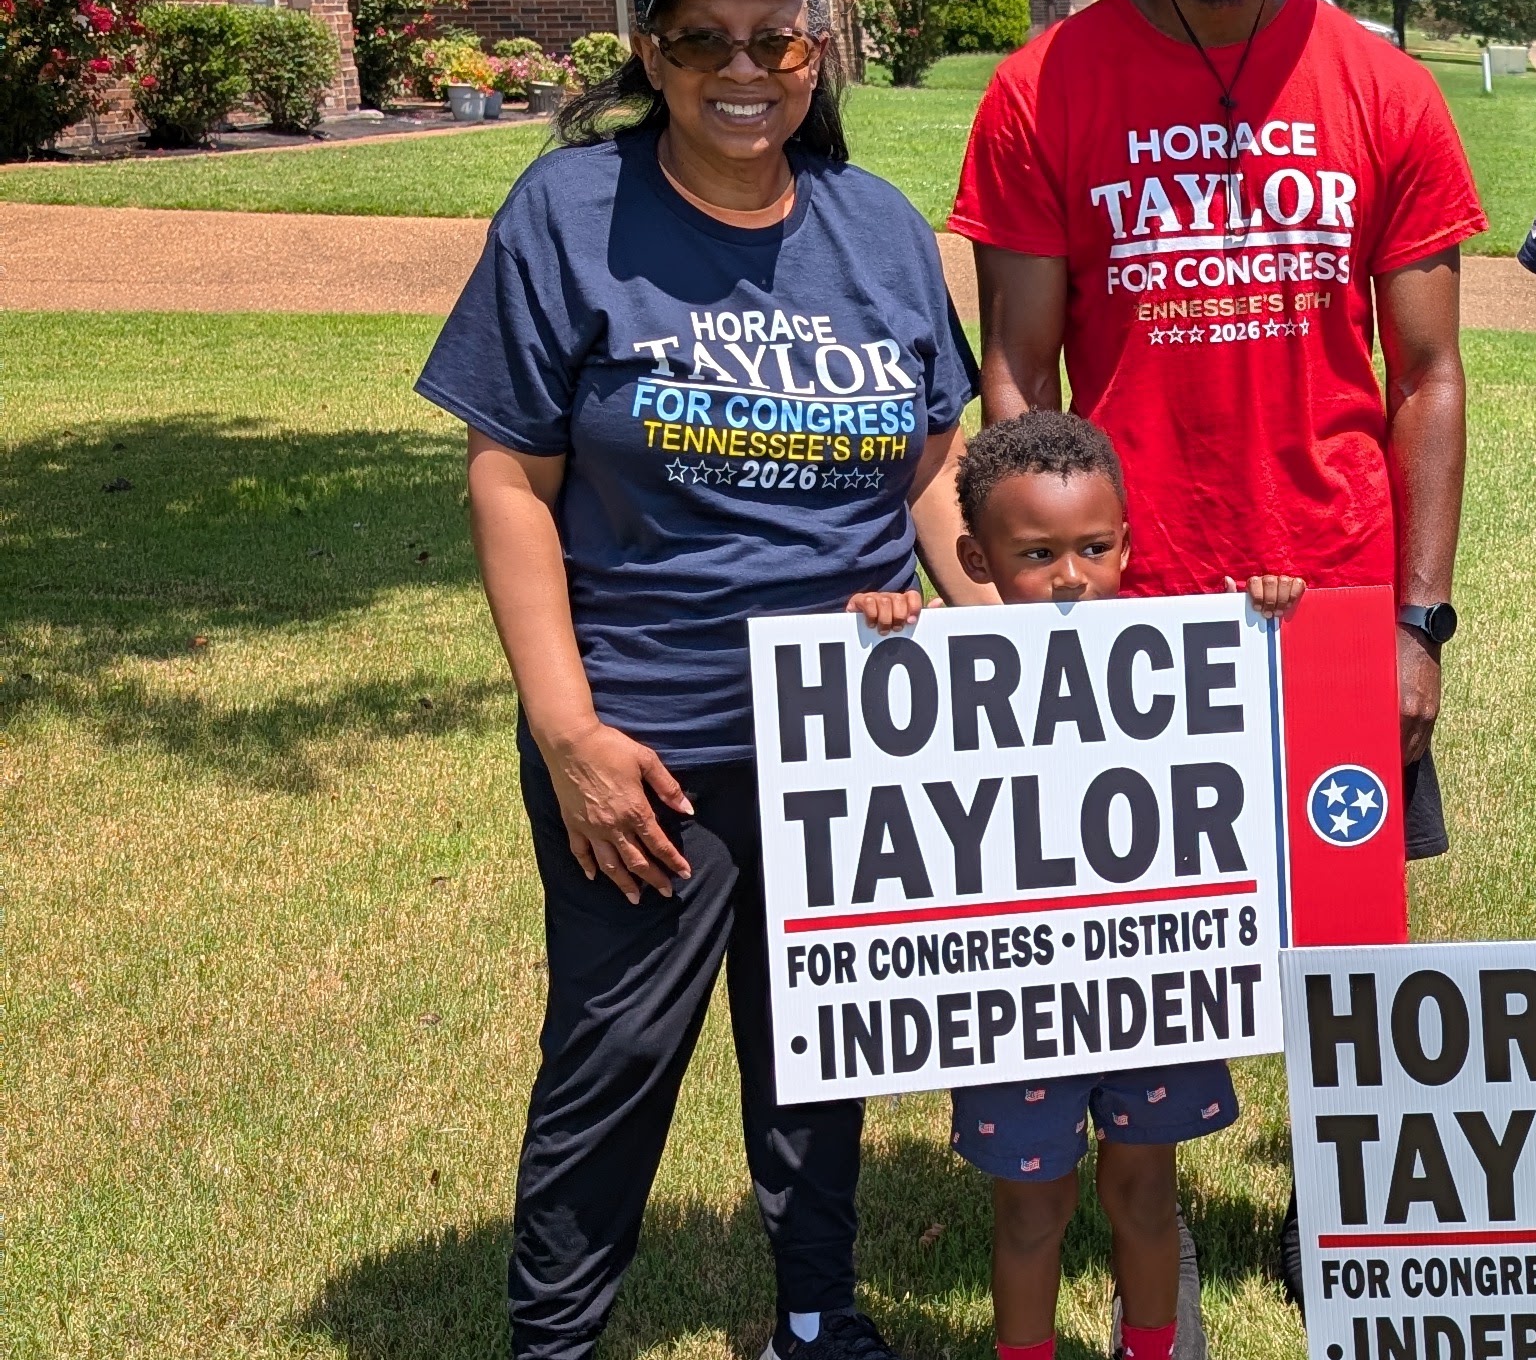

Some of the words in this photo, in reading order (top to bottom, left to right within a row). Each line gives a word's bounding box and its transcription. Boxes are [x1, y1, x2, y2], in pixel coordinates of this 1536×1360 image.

[1128, 120, 1317, 163] HORACE
[1090, 168, 1356, 239] TAYLOR
[1108, 262, 1167, 294] FOR
[1175, 252, 1349, 287] CONGRESS
[690, 310, 836, 343] HORACE
[1135, 293, 1283, 321] ENNESSEE'S
[1294, 292, 1330, 311] 8TH
[1209, 321, 1260, 342] 2026
[633, 336, 916, 395] TAYLOR
[632, 384, 713, 425] FOR
[725, 395, 916, 435] CONGRESS
[644, 421, 850, 461] TENNESSEE'S
[860, 435, 906, 461] 8TH
[738, 460, 819, 490] 2026
[774, 620, 1245, 763] HORACE
[783, 761, 1249, 908] TAYLOR
[787, 939, 857, 988] FOR
[868, 924, 1055, 981] CONGRESS
[1084, 908, 1229, 961] DISTRICT
[1238, 904, 1258, 947] 8
[818, 963, 1262, 1081] INDEPENDENT
[1321, 1257, 1391, 1300] FOR
